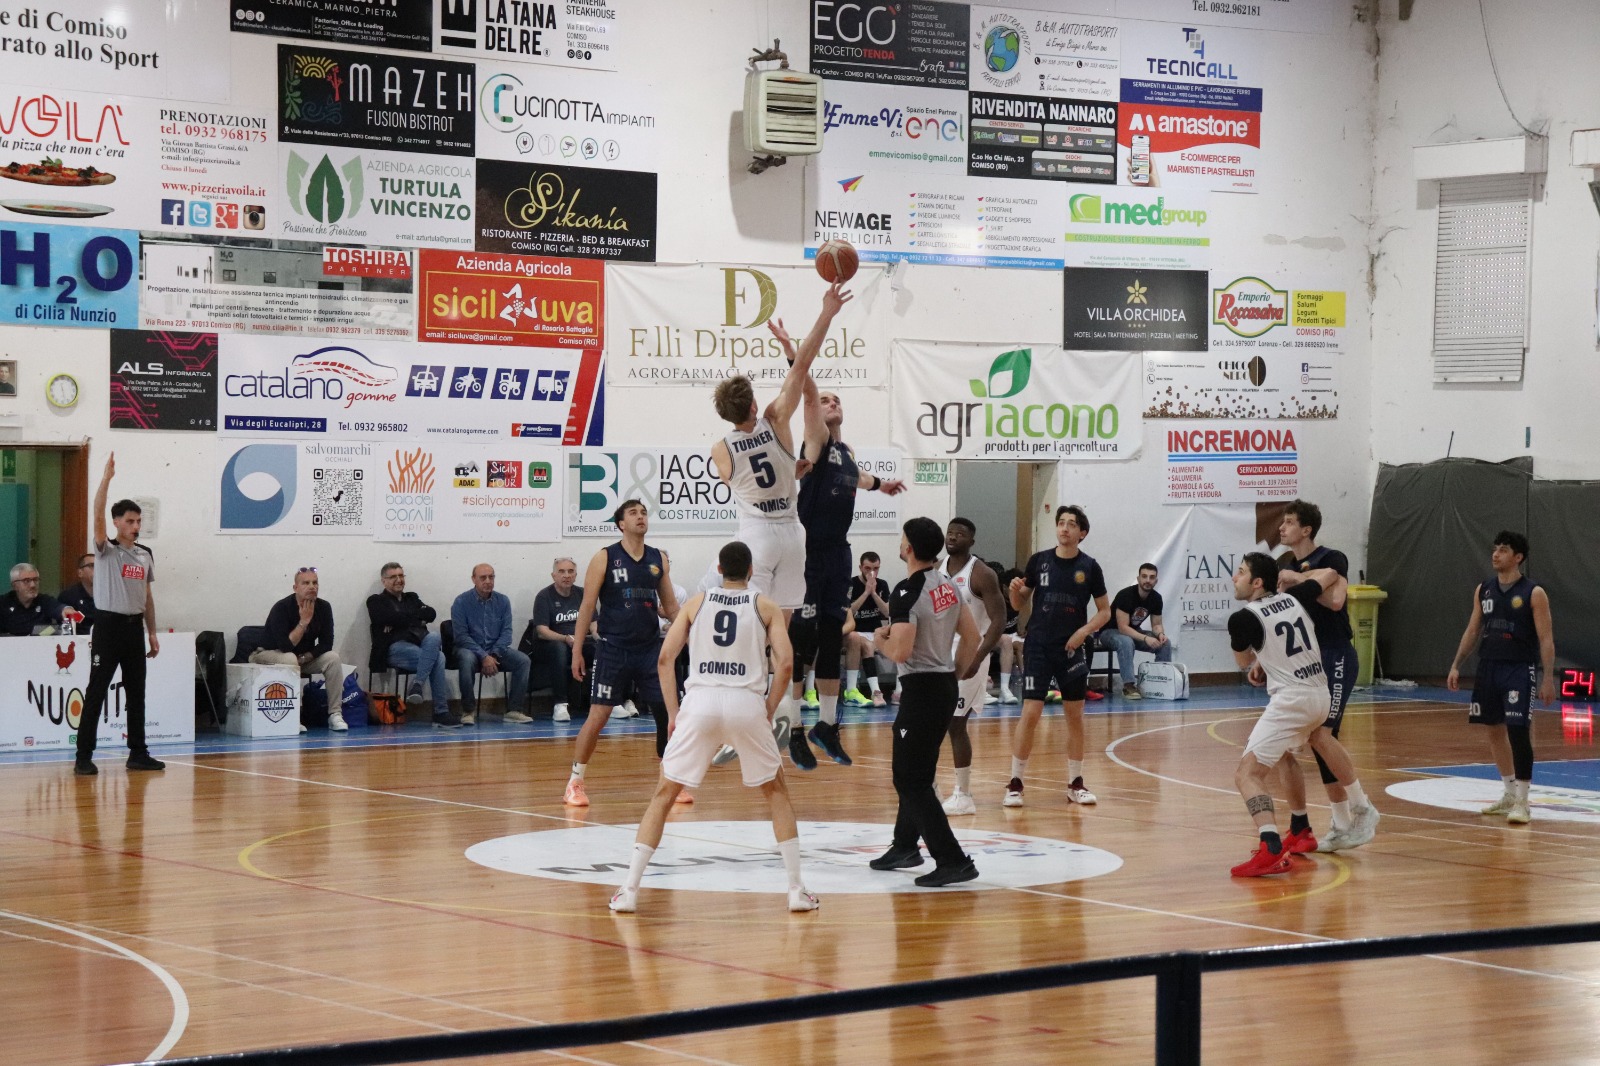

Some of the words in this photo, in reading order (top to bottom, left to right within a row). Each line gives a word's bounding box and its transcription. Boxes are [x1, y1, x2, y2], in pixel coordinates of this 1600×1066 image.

[486, 0, 507, 24] LA
[511, 1, 556, 29] TANA
[566, 5, 615, 19] STEAKHOUSE
[1193, 0, 1208, 11] Tel.
[1211, 2, 1261, 16] 0932.962181
[18, 9, 38, 28] di
[46, 11, 127, 40] Comiso
[485, 25, 516, 52] DEL
[520, 29, 541, 55] RE
[567, 32, 587, 40] COMISO
[2, 36, 46, 55] rato
[55, 40, 93, 61] allo
[101, 44, 159, 70] Sport
[1147, 58, 1238, 80] TECNICALL
[349, 62, 472, 112] MAZEH
[1133, 81, 1160, 89] SERRAMENTI
[972, 97, 1046, 119] RIVENDITA
[1049, 103, 1116, 124] NANNARO
[160, 109, 266, 129] PRENOTAZIONI
[367, 110, 407, 129] FUSION
[410, 113, 454, 132] BISTROT
[607, 112, 655, 128] IMPIANTI
[1158, 114, 1248, 137] amastone
[161, 124, 180, 135] tel.
[185, 126, 216, 139] 0932
[221, 127, 267, 143] 968175
[906, 113, 964, 142] enel
[13, 140, 42, 152] pizza
[46, 142, 66, 154] che
[70, 145, 92, 156] non
[161, 146, 189, 154] COMISO
[183, 156, 240, 165] info@pizzeriavoila.it
[869, 150, 964, 163] emmevicomiso@gmail.com
[1180, 153, 1226, 164] E-COMMERCE
[1227, 156, 1241, 164] PER
[367, 160, 415, 174] AZIENDA
[418, 164, 472, 178] AGRICOLA
[972, 162, 994, 170] COMISO
[1167, 164, 1200, 175] MARMISTI
[1207, 166, 1255, 177] PIASTRELLISTI
[162, 182, 266, 197] www.pizzeriavoila.it
[379, 178, 462, 199] TURTULA
[505, 171, 629, 231] Sikania
[370, 198, 471, 221] VINCENZO
[283, 221, 314, 234] Passioni
[315, 223, 327, 235] che
[481, 228, 532, 240] RISTORANTE
[540, 232, 574, 243] PIZZERIA
[582, 235, 597, 245] BED
[607, 236, 650, 248] BREAKFAST
[512, 242, 542, 252] COMISO
[578, 246, 590, 254] 328
[592, 247, 622, 256] 2987337
[325, 248, 410, 267] TOSHIBA
[328, 265, 406, 276] PARTNER
[457, 256, 512, 273] Azienda
[515, 259, 572, 276] Agricola
[1238, 291, 1271, 302] Emporio
[1297, 293, 1324, 302] Formaggi
[15, 304, 28, 318] di
[33, 304, 65, 320] Cilia
[71, 306, 117, 322] Nunzio
[1087, 308, 1122, 321] VILLA
[1124, 308, 1186, 322] ORCHIDEA
[1297, 309, 1318, 317] Legumi
[146, 318, 155, 326] Via
[542, 324, 564, 333] Rosario
[566, 326, 593, 334] Battaglia
[426, 332, 447, 340] email:
[447, 332, 513, 342] siciluva@gmail.com
[559, 337, 582, 345] Comiso
[584, 338, 598, 347] (RG)
[1108, 332, 1147, 340] TRATTENIMENTI
[1296, 328, 1321, 336] COMISO
[1322, 329, 1336, 337] (RG)
[629, 326, 683, 358] F.lli
[694, 328, 866, 368] Dipasale
[116, 361, 164, 375] ALS
[761, 368, 867, 379] FERIZZANTI
[225, 367, 343, 400] catalano
[344, 391, 397, 409] gomme
[230, 418, 244, 427] Via
[246, 419, 266, 430] degli
[269, 419, 310, 430] Eucalipti,
[312, 421, 322, 429] 28
[339, 422, 352, 431] Tel.
[354, 422, 376, 432] 0932
[377, 423, 408, 433] 965802
[426, 427, 499, 435] www.catalanogomme.com
[916, 401, 1119, 454] agriacono
[732, 430, 773, 453] TURNER
[985, 440, 1029, 455] prodotti
[1032, 442, 1051, 454] per
[1054, 440, 1118, 455] l'agricoltura
[1168, 429, 1296, 453] INCREMONA
[305, 443, 371, 456] salvomarchi
[828, 447, 842, 465] 26
[491, 462, 517, 478] Sicily
[749, 452, 776, 488] 5
[875, 461, 896, 472] (RG)
[916, 462, 939, 472] USCITA
[1239, 466, 1262, 474] SERVIZIO
[458, 479, 475, 487] ADAC
[489, 479, 517, 488] TOUR
[915, 473, 948, 483] SICUREZZA
[659, 482, 737, 504] BARO
[463, 495, 545, 509] #sicilycamping
[659, 509, 739, 521] COSTRUZION
[568, 525, 597, 533] IMPRESA
[612, 568, 628, 584] 14
[709, 593, 750, 606] TARTAGLIA
[1200, 599, 1230, 610] GULFI
[1482, 599, 1493, 614] 20
[801, 603, 817, 619] 26
[1261, 598, 1295, 617] D'URZO
[713, 610, 738, 647] 9
[1274, 617, 1312, 657] 21
[699, 661, 746, 676] COMISO
[1025, 676, 1035, 690] 11
[1562, 670, 1594, 697] 24
[597, 684, 612, 699] 14
[257, 699, 294, 708] OLYMPIA
[1329, 684, 1343, 719] REGGIO
